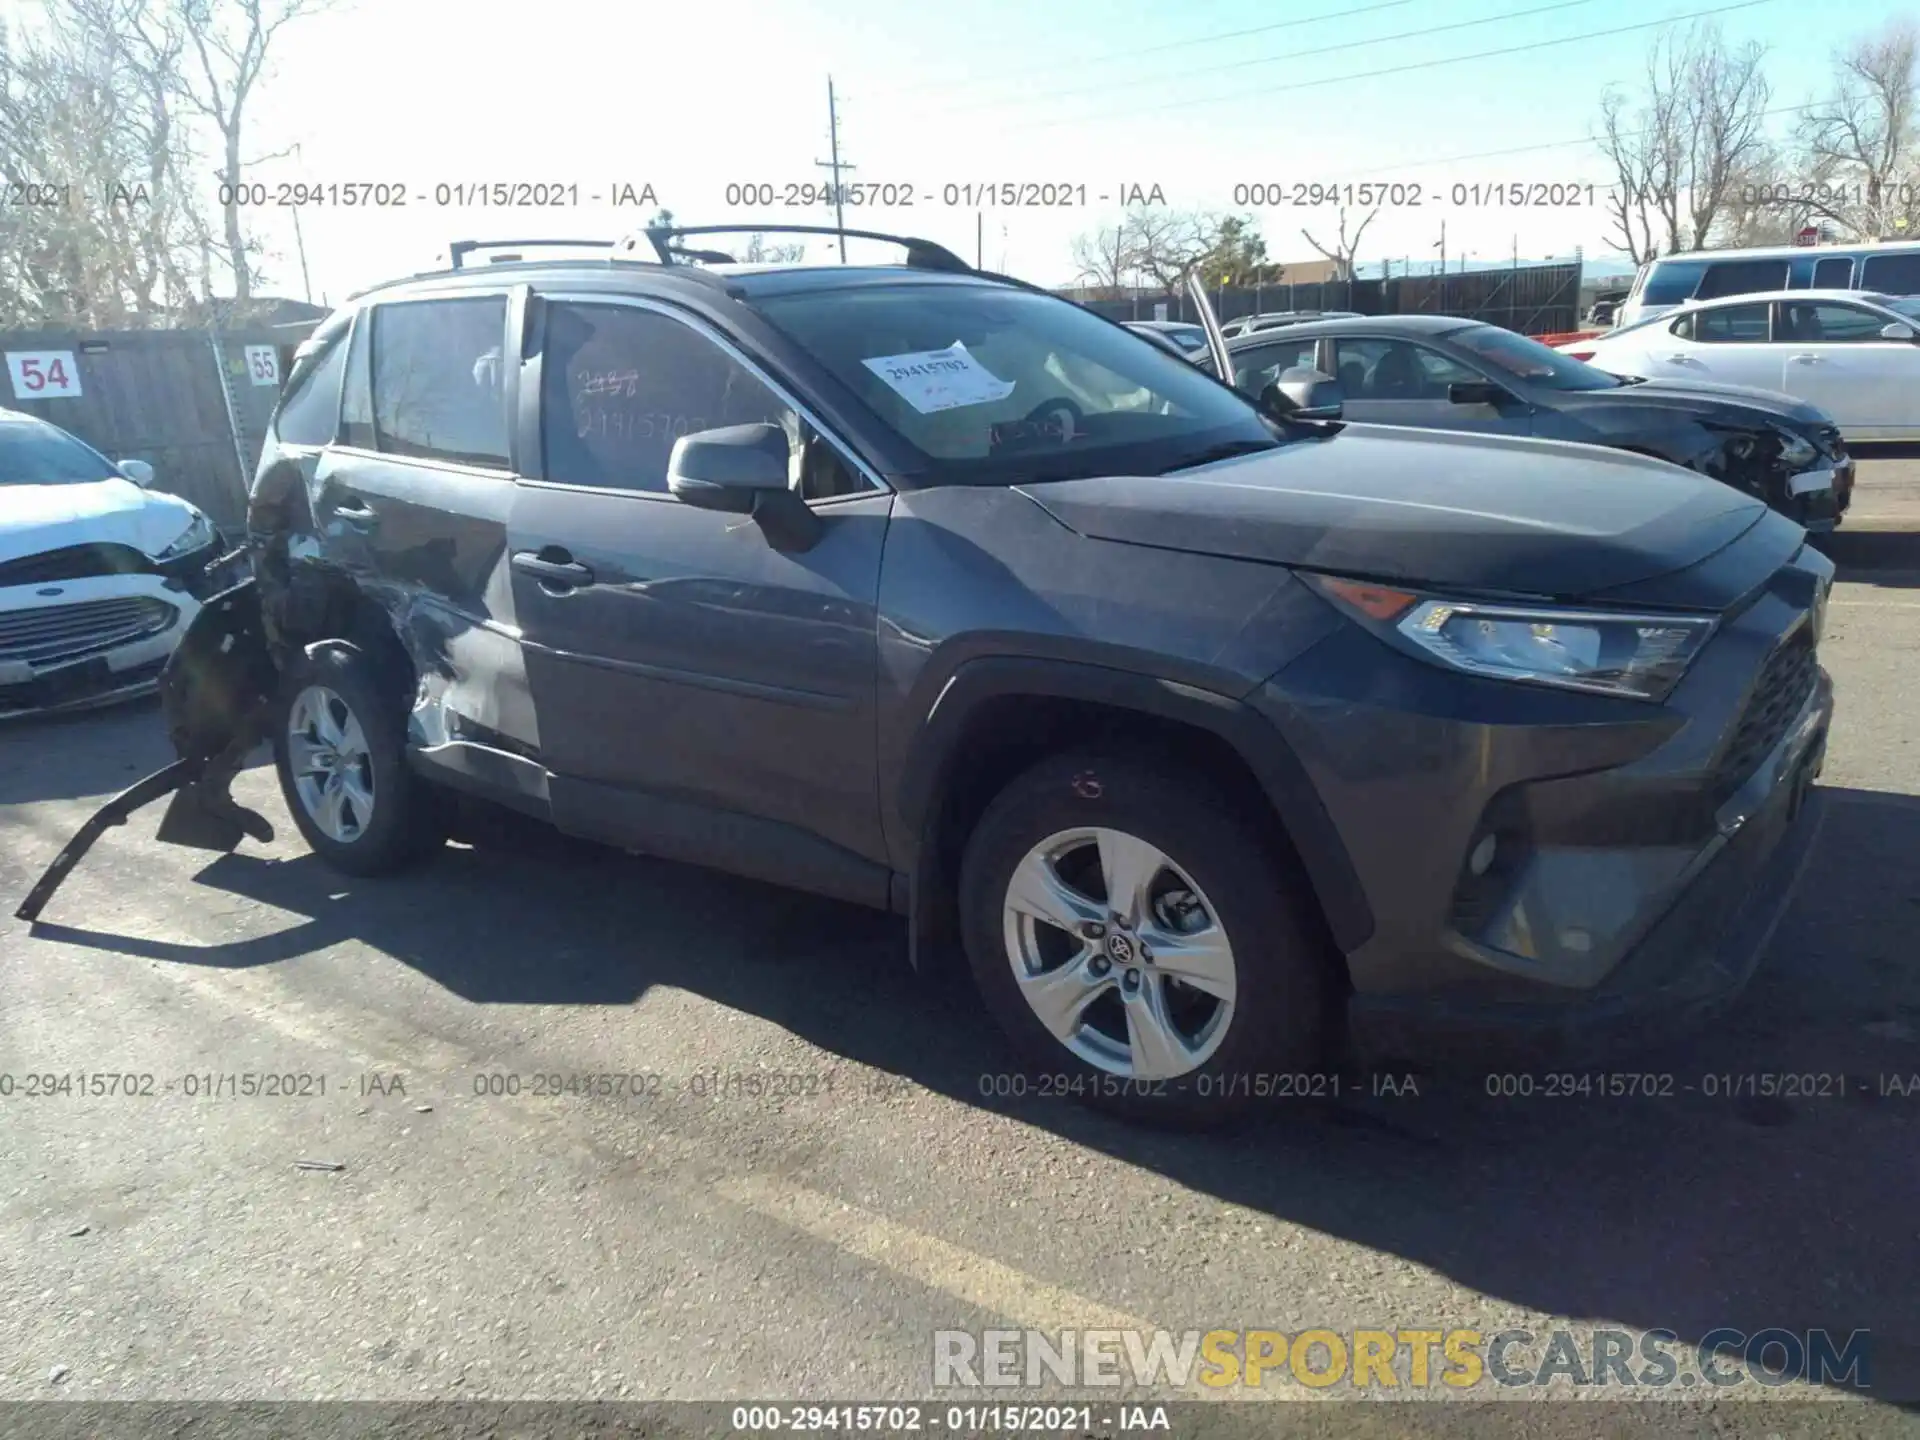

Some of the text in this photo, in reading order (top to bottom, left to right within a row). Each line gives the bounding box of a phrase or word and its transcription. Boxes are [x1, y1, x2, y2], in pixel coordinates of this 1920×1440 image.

[20, 358, 69, 391] 54
[251, 352, 274, 379] 55
[886, 359, 969, 380] 29415702
